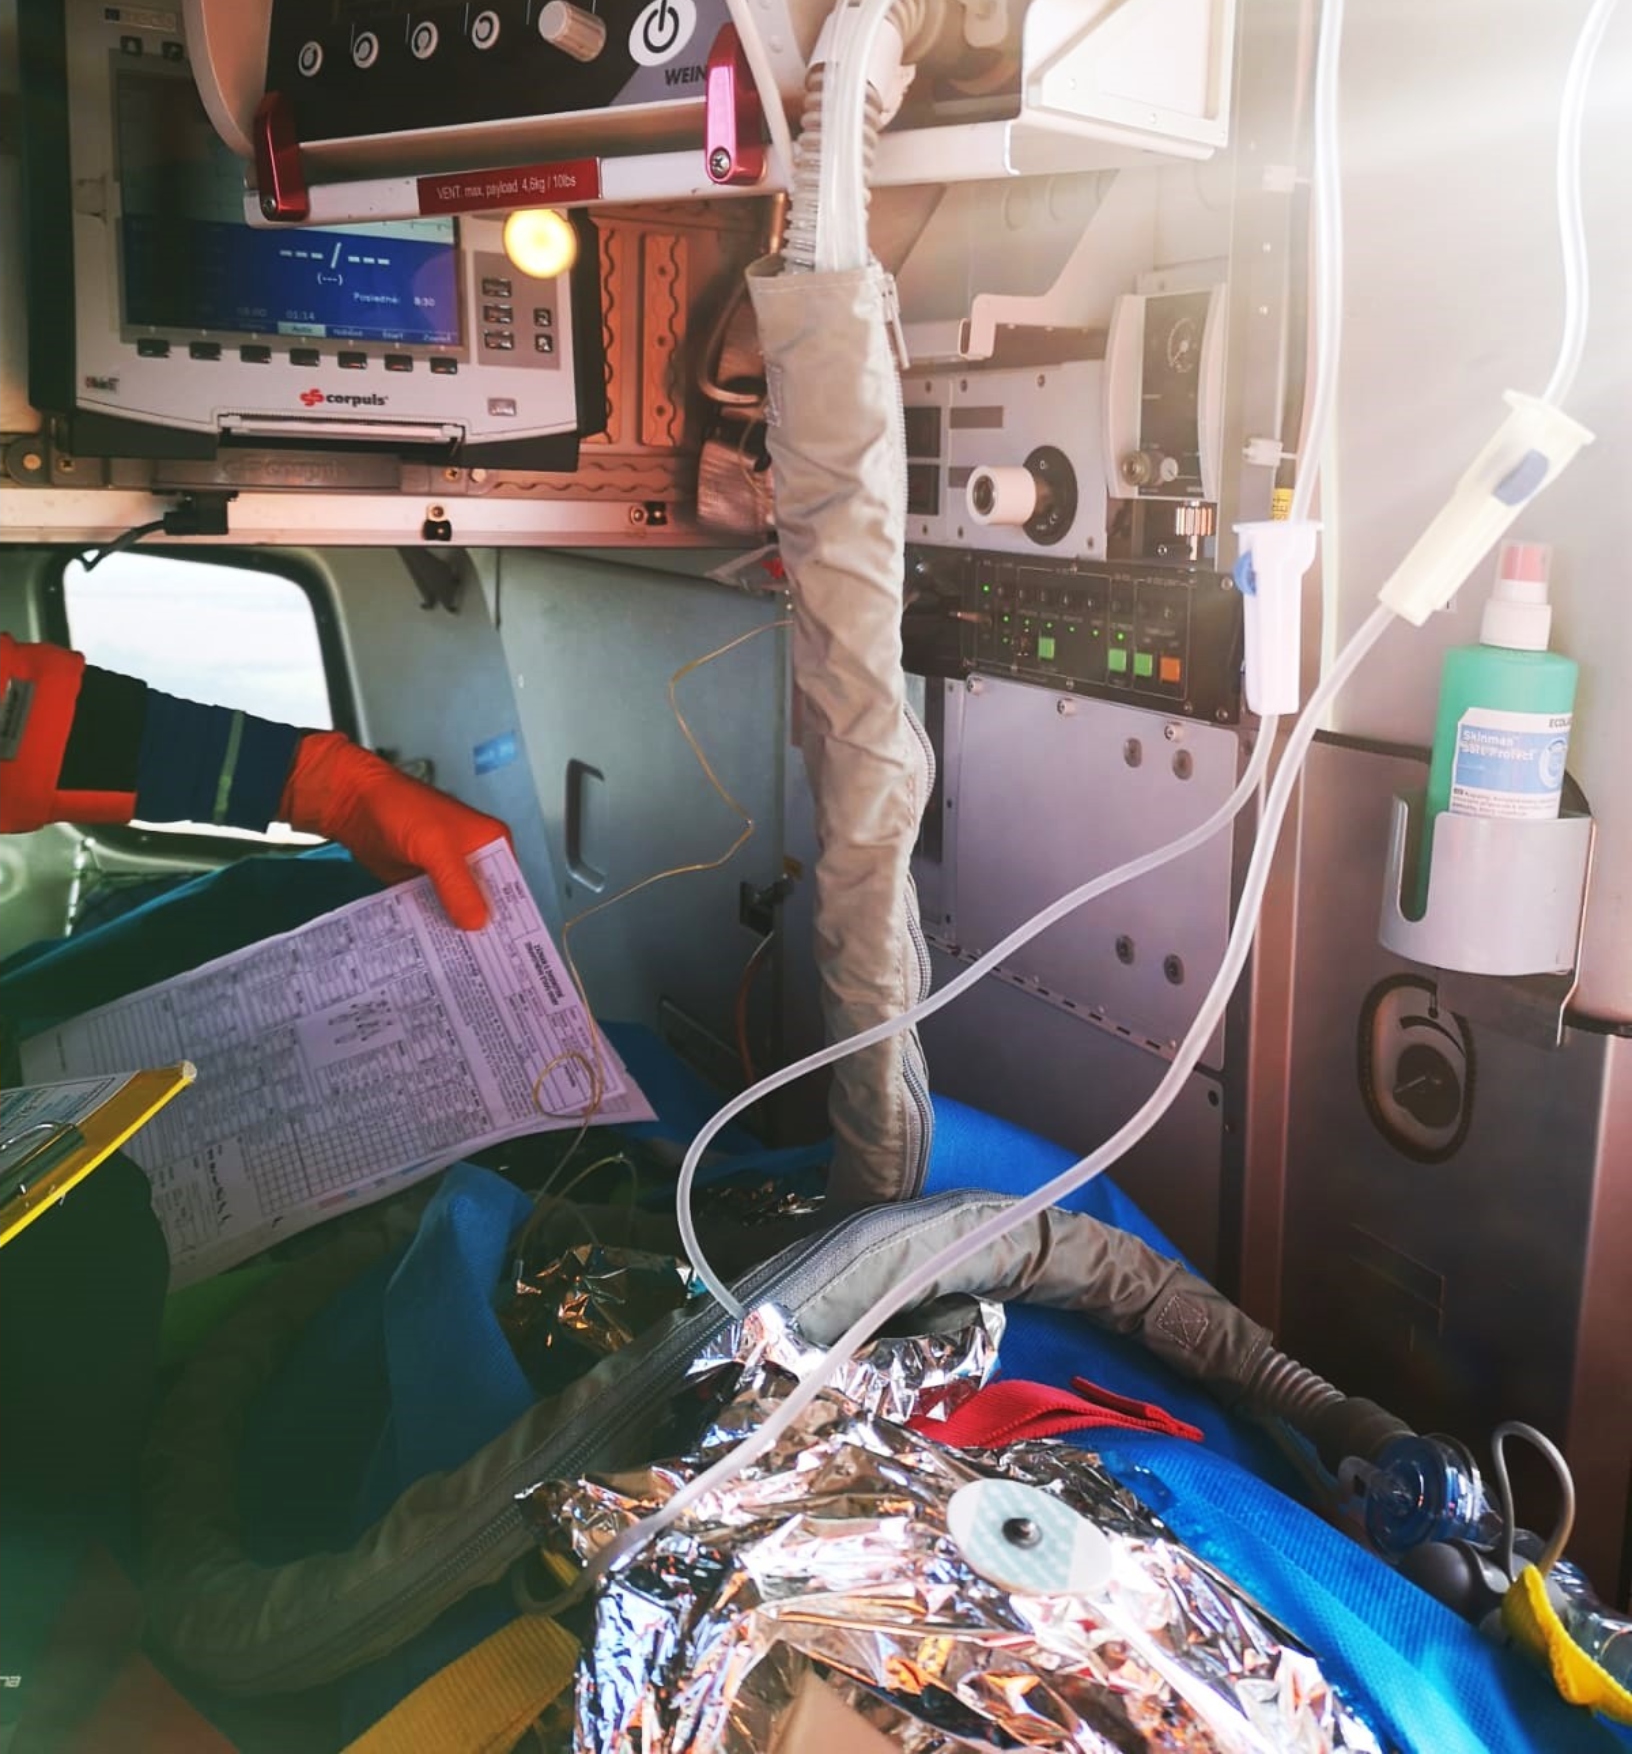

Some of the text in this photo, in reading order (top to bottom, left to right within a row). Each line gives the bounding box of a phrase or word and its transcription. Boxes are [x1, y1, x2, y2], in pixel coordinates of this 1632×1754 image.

[485, 179, 518, 199] payload
[553, 174, 577, 188] 10lbs
[326, 394, 386, 408] corpuls
